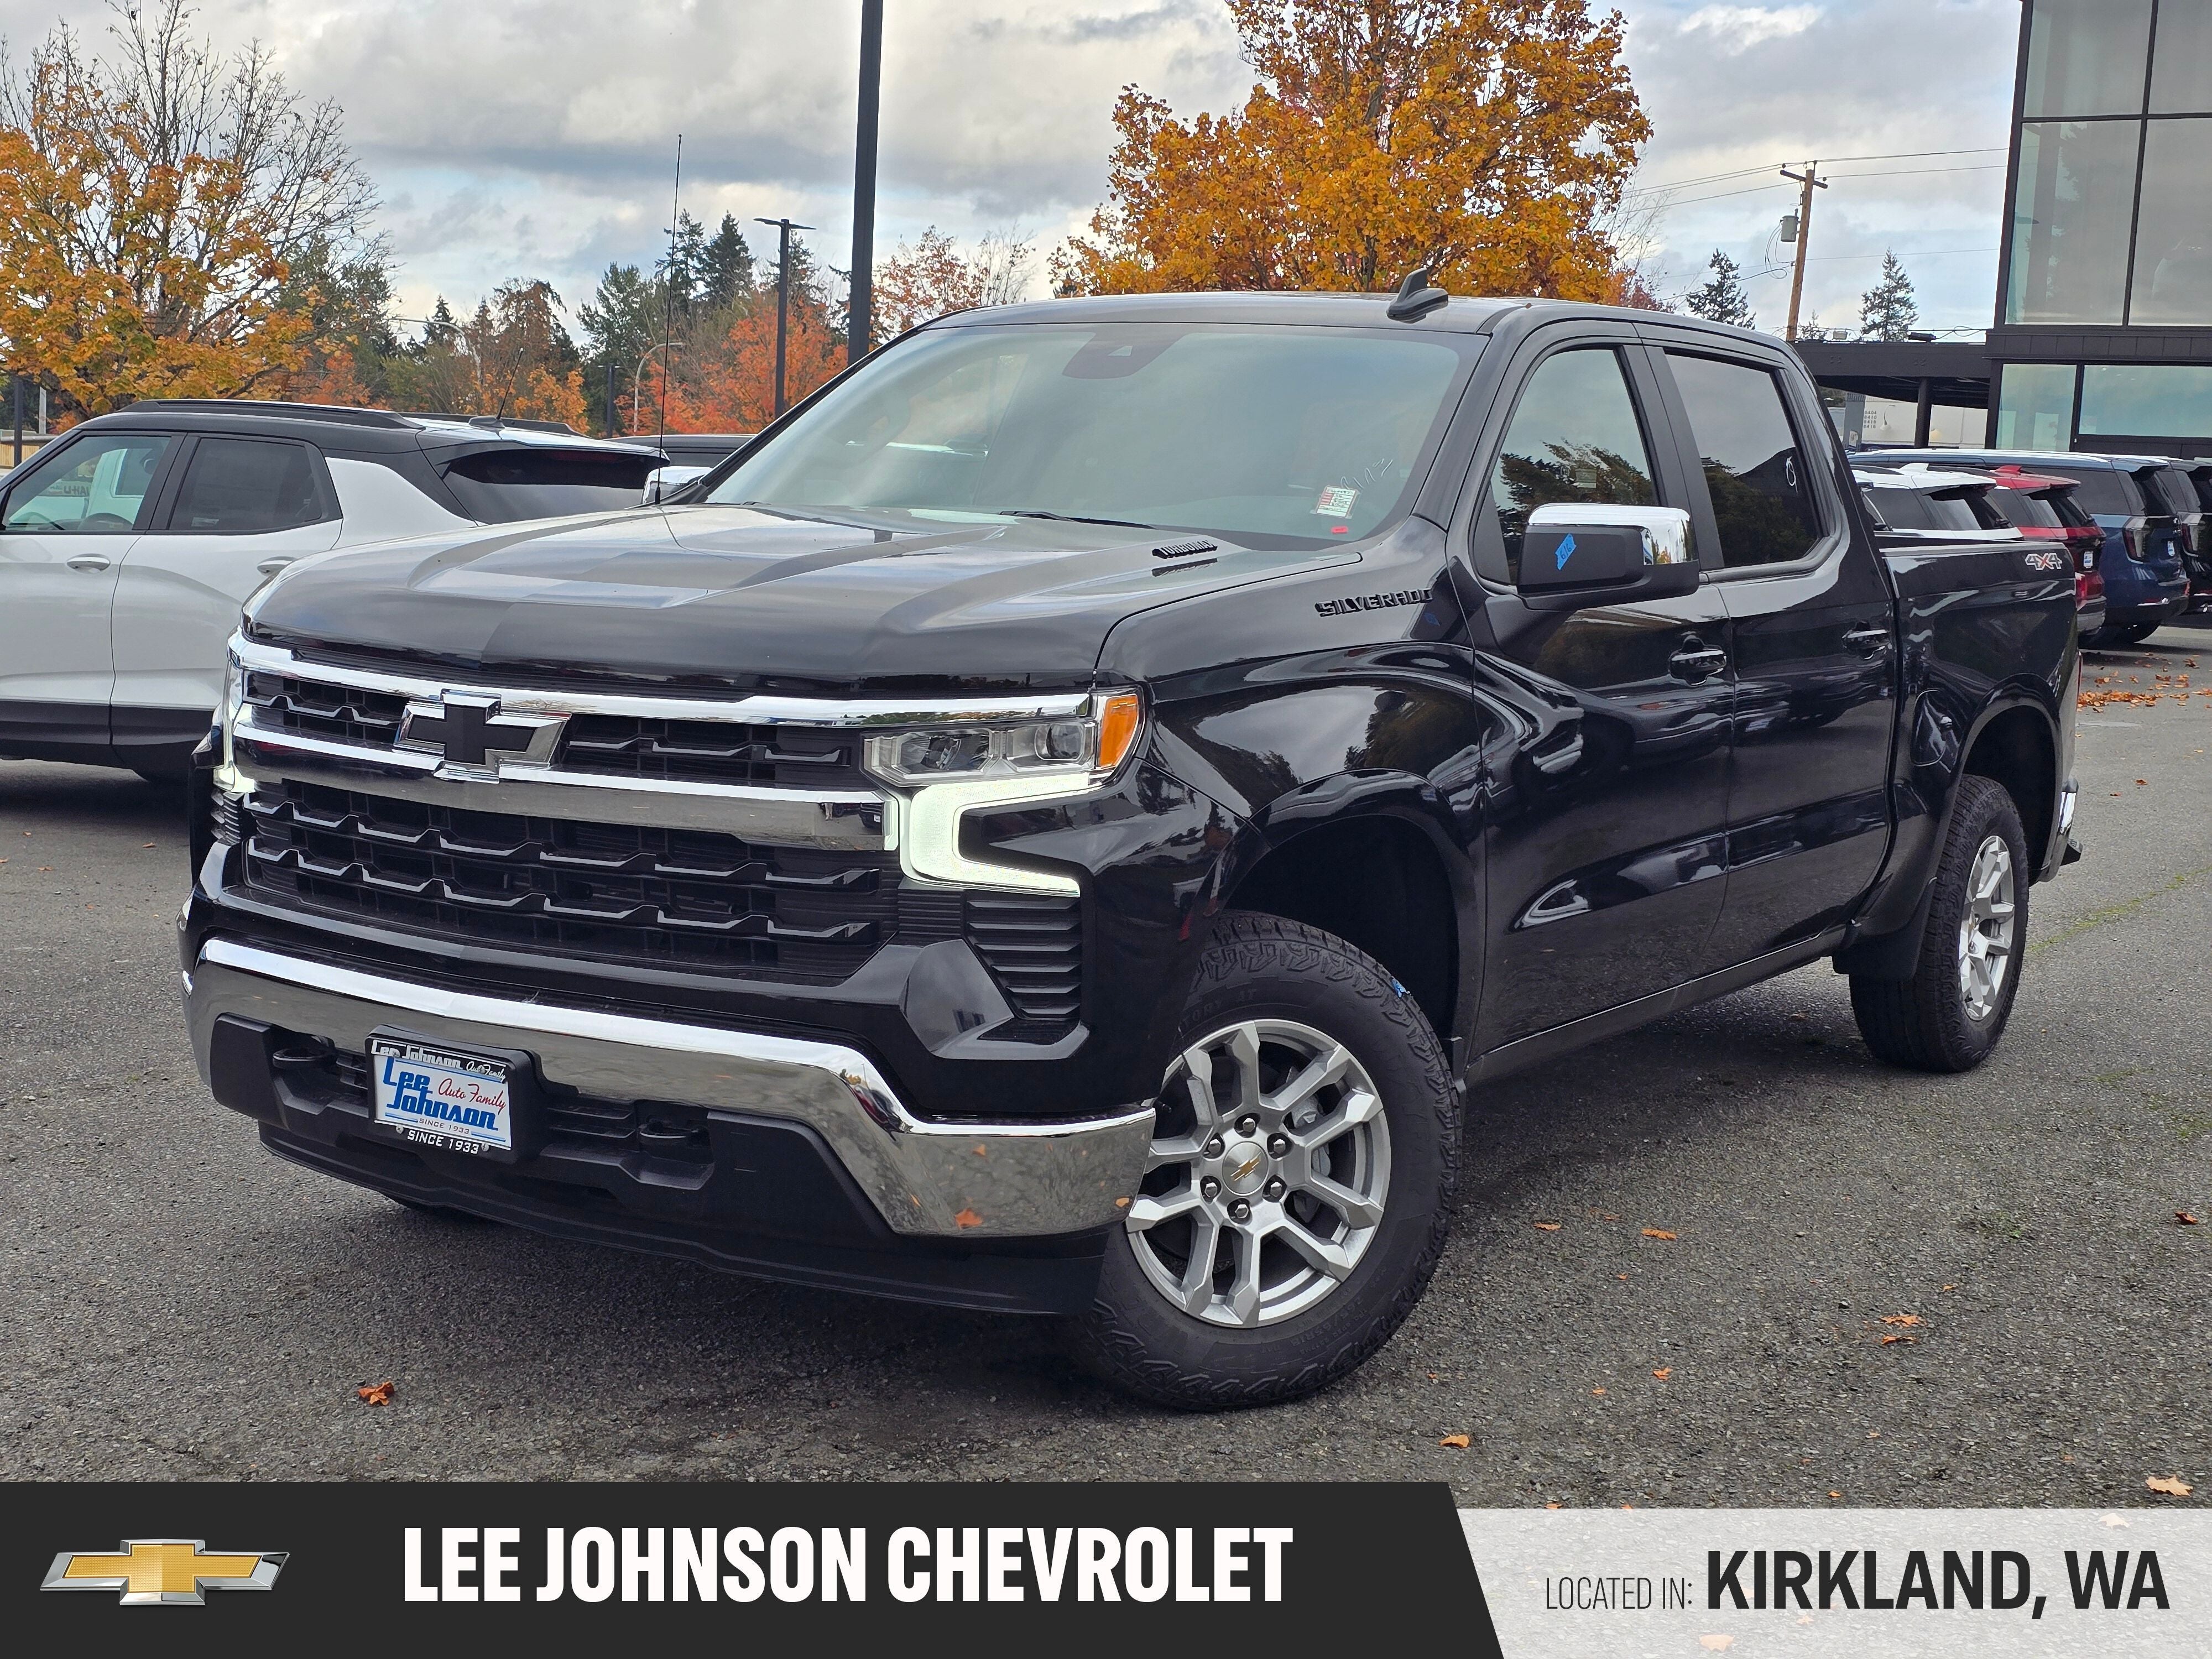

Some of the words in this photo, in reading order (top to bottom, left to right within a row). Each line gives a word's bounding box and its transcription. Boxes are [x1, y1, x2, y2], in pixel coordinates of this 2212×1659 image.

[1314, 589, 1433, 617] SILVERADO
[402, 1045, 463, 1070] Johnson
[383, 1057, 430, 1091] Lee
[439, 1078, 466, 1099] Auto
[468, 1083, 506, 1115] Family
[387, 1085, 499, 1131] Johnson
[419, 1118, 445, 1129] SINCE
[448, 1124, 469, 1134] 1933
[407, 1130, 444, 1147] SINCE
[448, 1139, 479, 1154] 1933
